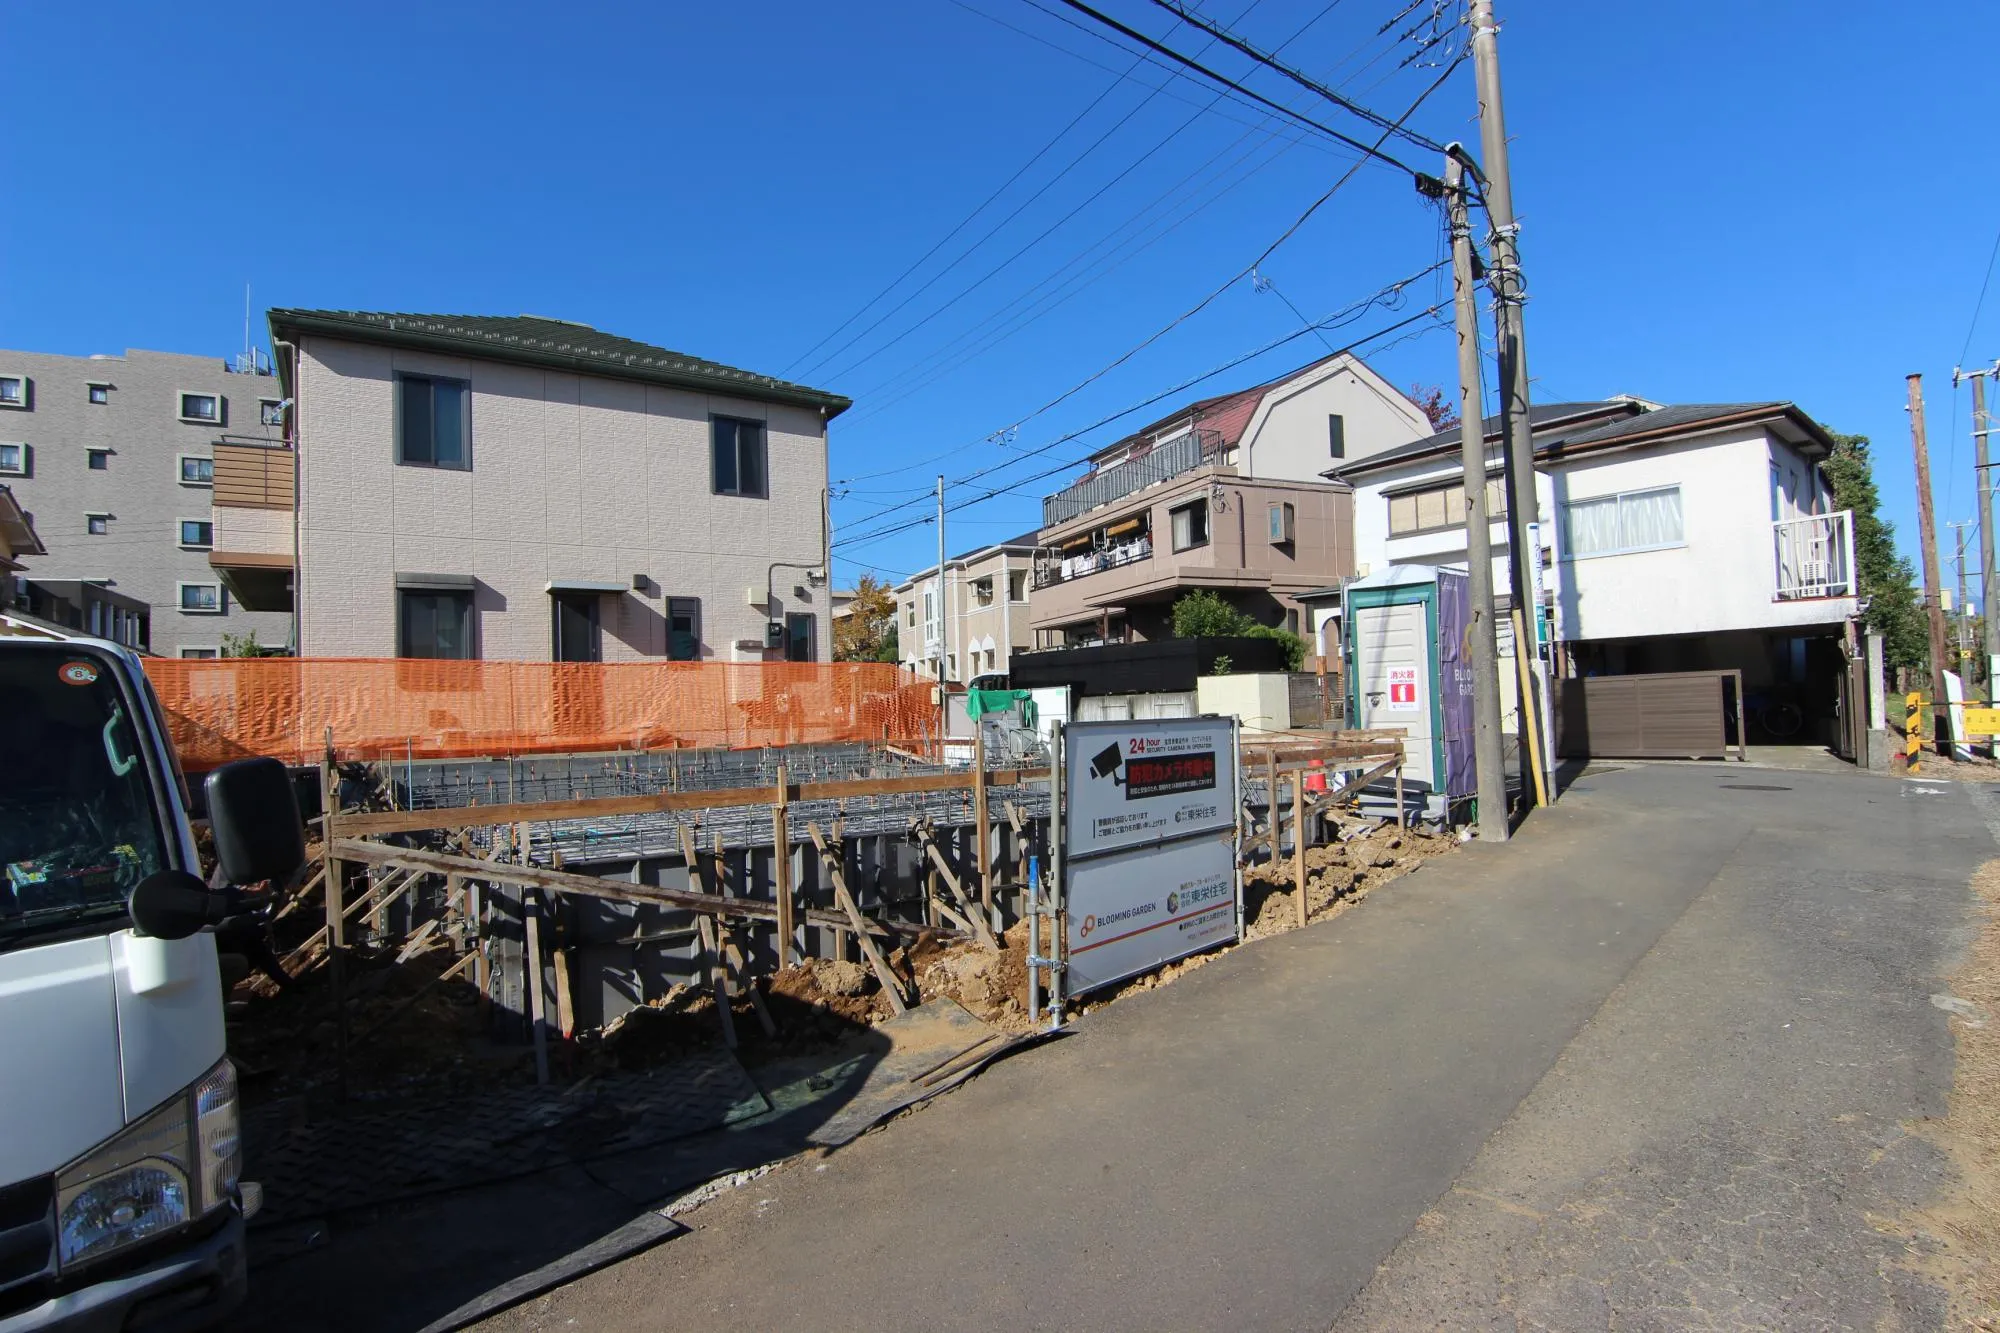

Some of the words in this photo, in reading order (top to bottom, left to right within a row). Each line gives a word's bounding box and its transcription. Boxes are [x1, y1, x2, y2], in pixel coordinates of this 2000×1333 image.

[1391, 670, 1415, 679] 消火器
[1130, 737, 1145, 754] 24
[1147, 738, 1161, 746] hour
[1188, 806, 1217, 821] 東栄住宅
[1191, 881, 1228, 903] 東栄住宅
[1097, 910, 1131, 927] BLOOMING
[1132, 902, 1156, 917] GARDEN
